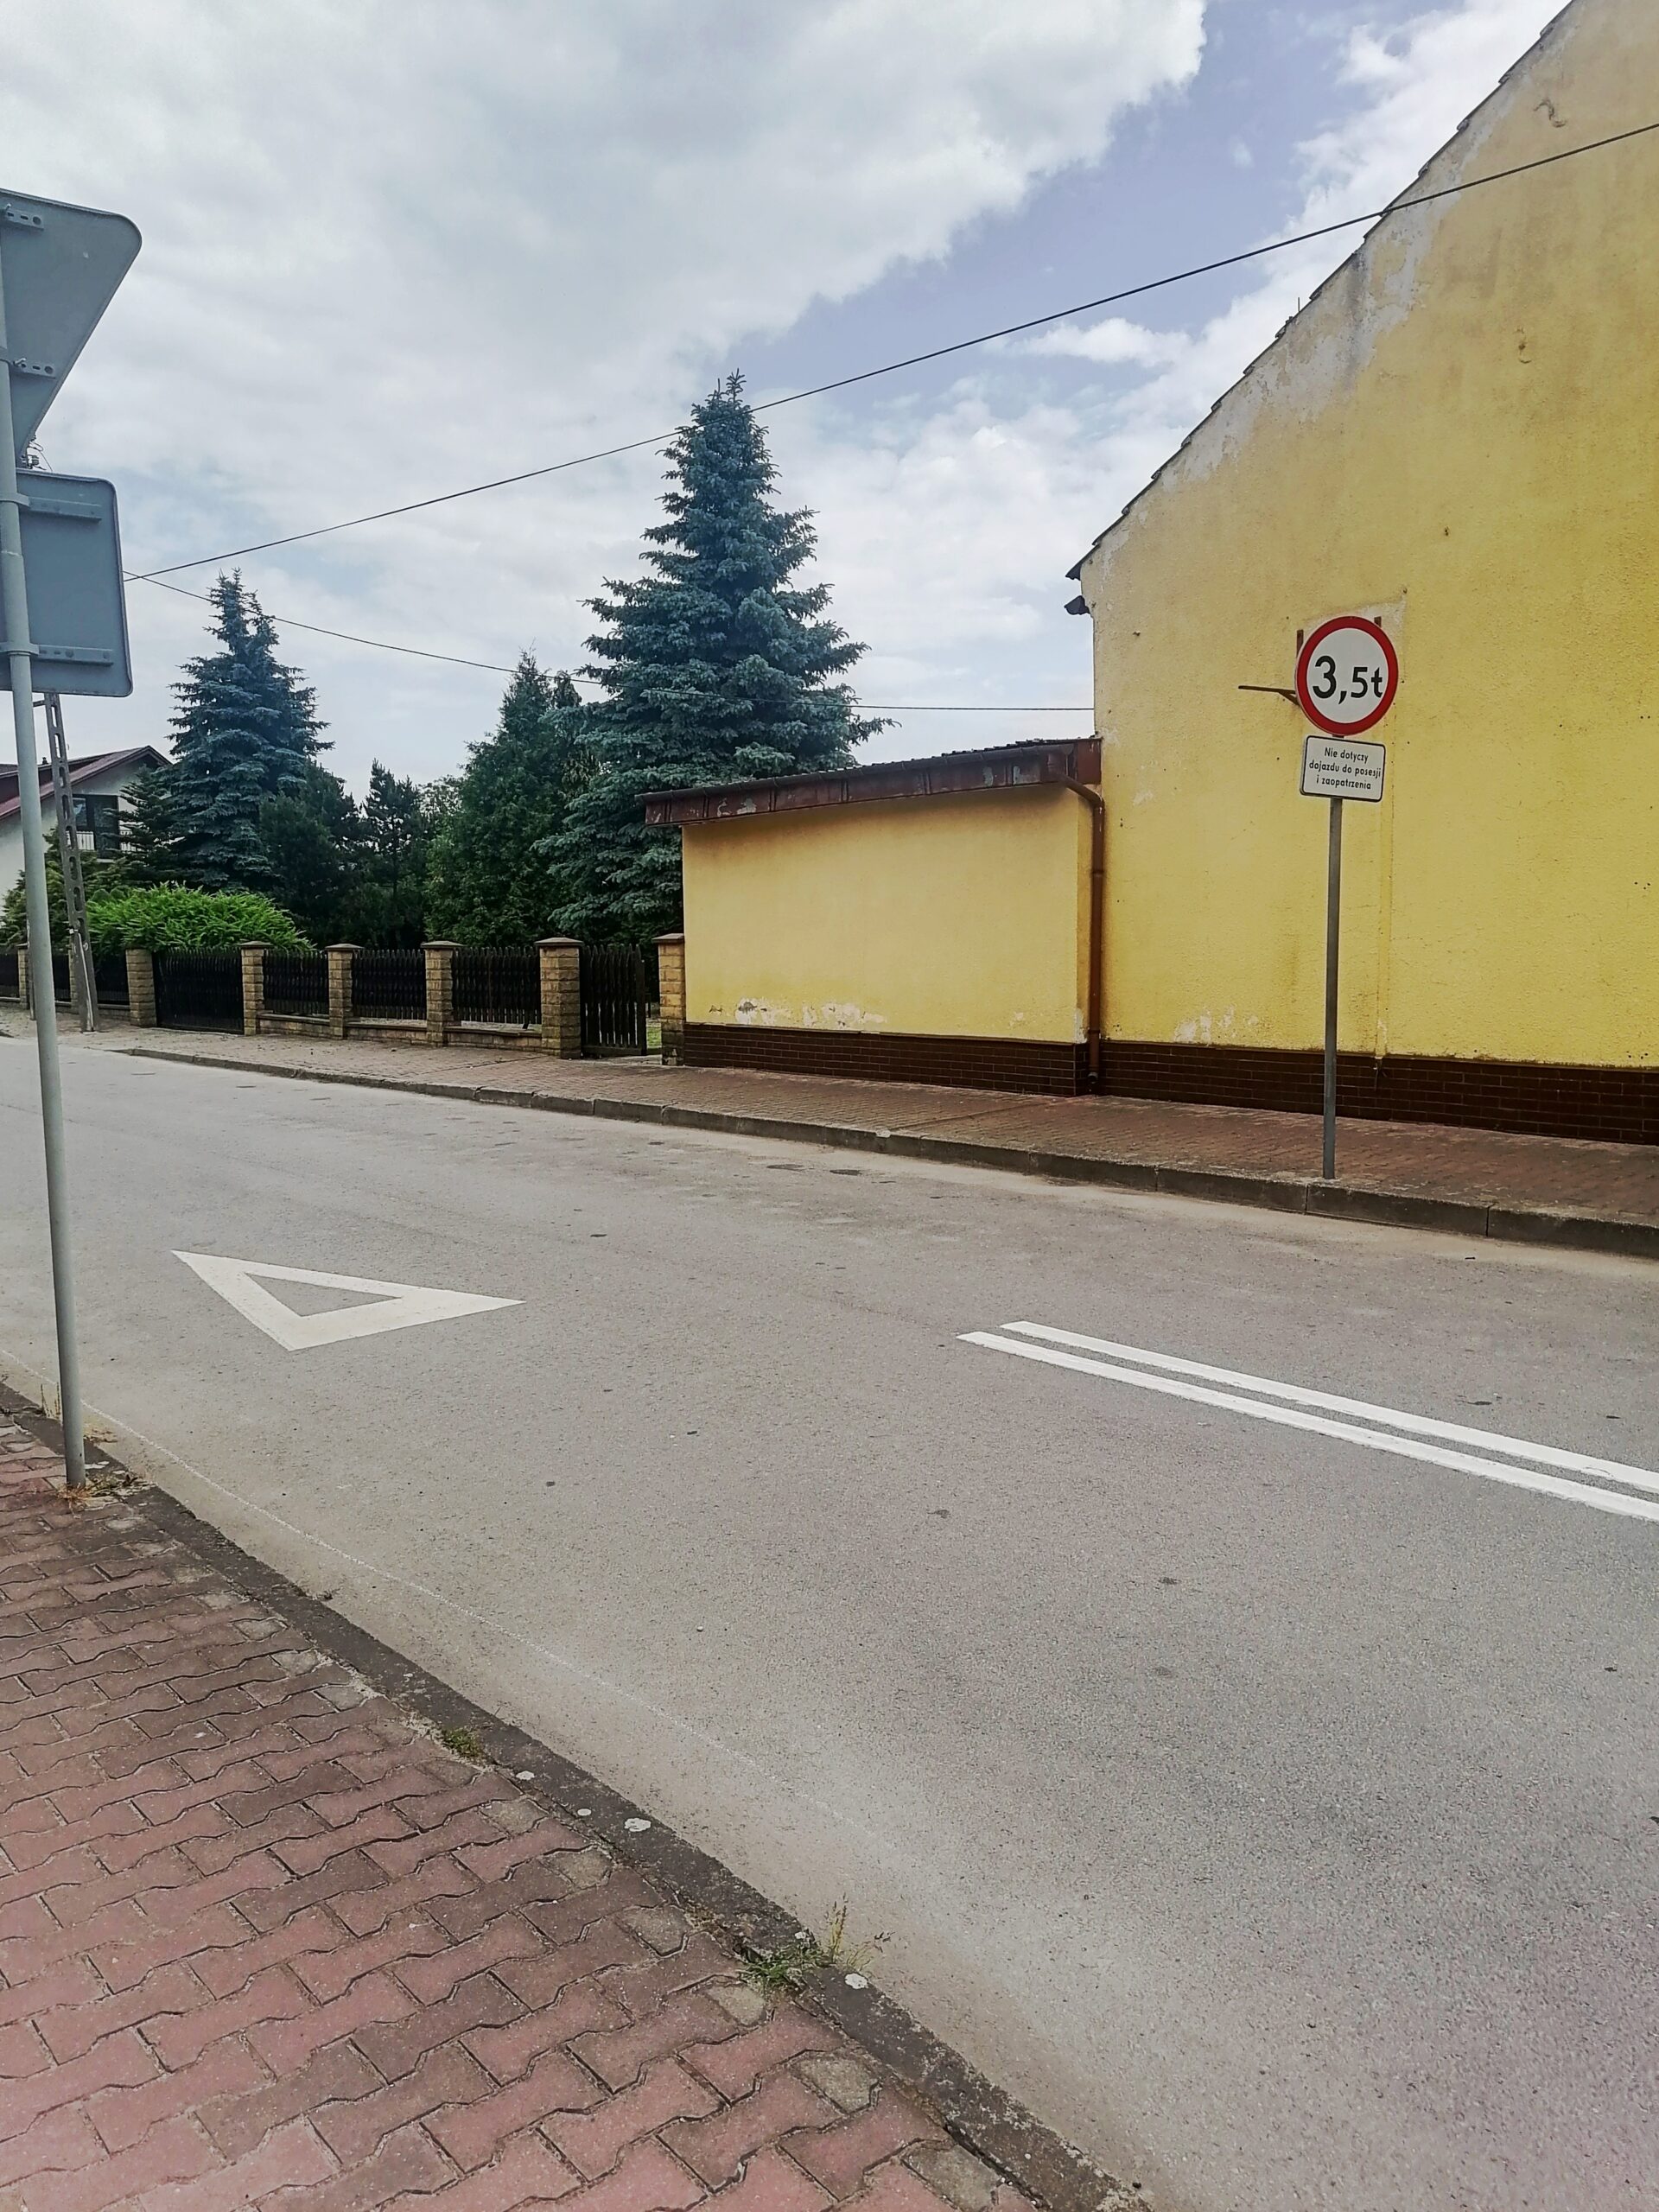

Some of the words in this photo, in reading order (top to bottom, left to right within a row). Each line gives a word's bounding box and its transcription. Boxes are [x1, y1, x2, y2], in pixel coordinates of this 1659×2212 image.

[1313, 655, 1382, 705] 3,5t
[1324, 747, 1338, 758] Nie
[1340, 749, 1369, 764] dotyczy
[1308, 760, 1340, 772] dojazdu
[1342, 764, 1352, 773] do
[1354, 767, 1382, 779] posesji
[1321, 777, 1371, 790] zaopatrzenia
